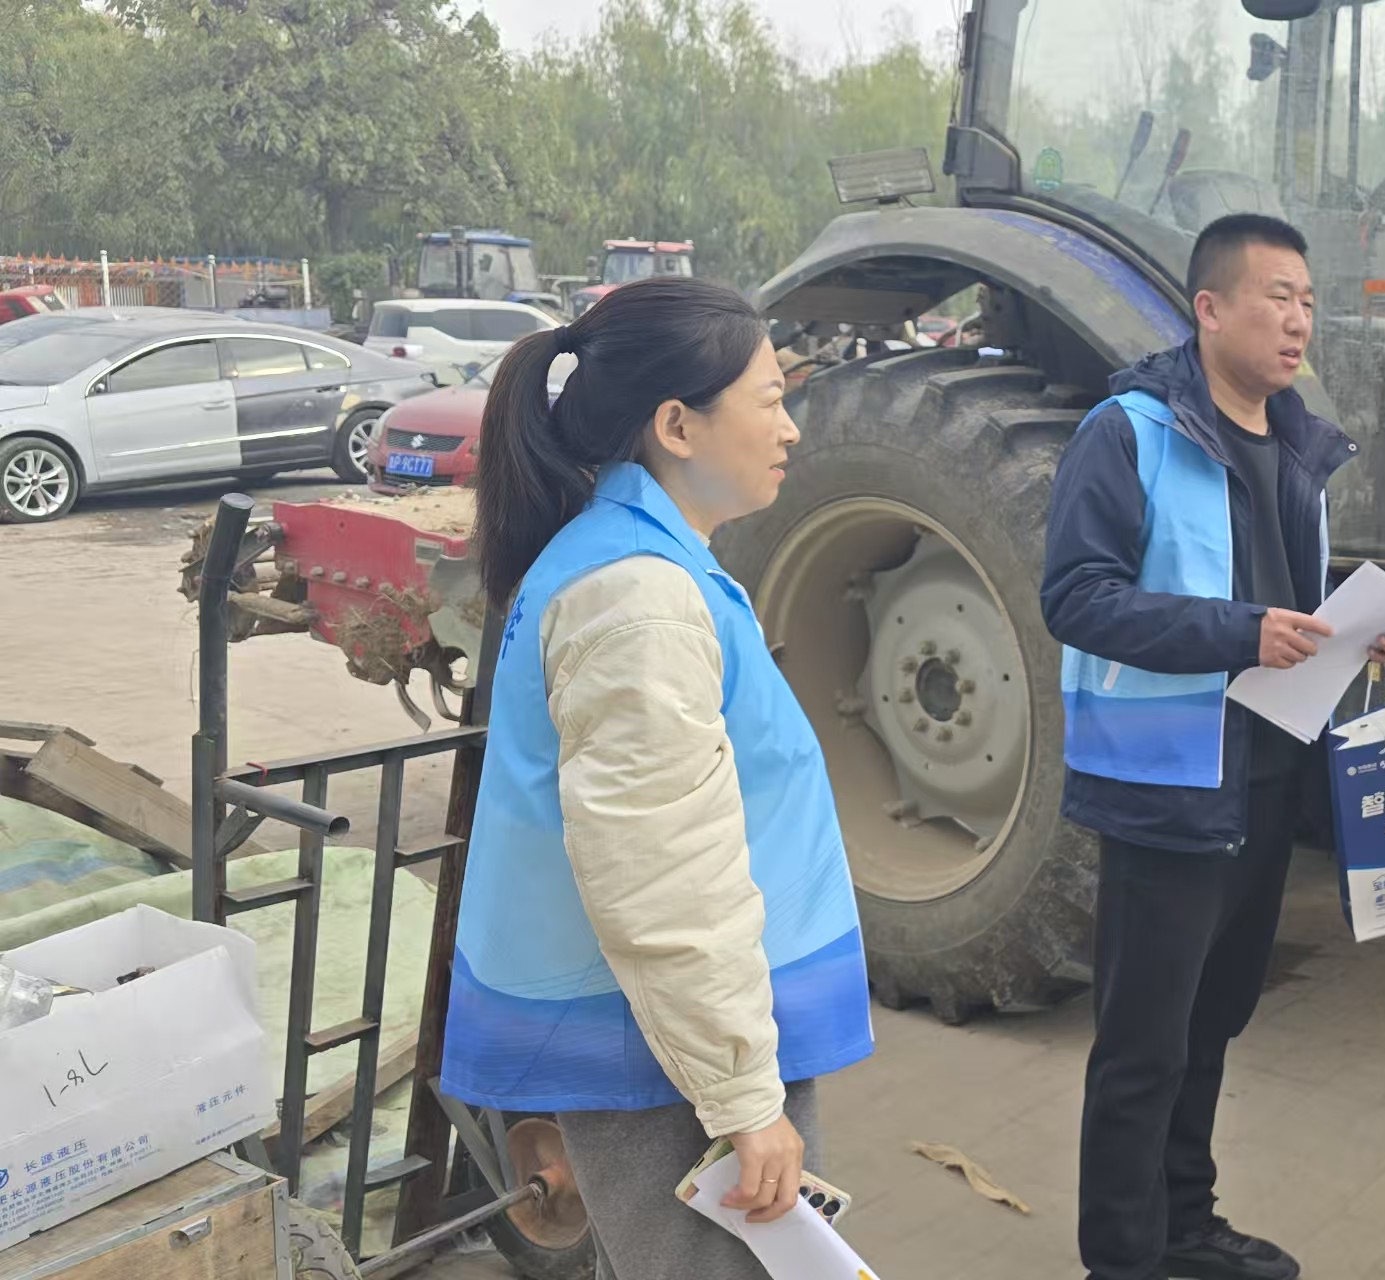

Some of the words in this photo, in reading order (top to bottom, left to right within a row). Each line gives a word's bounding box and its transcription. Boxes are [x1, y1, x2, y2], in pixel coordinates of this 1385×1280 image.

[195, 1083, 249, 1116] 液压元件
[24, 1139, 88, 1173] 长源液压
